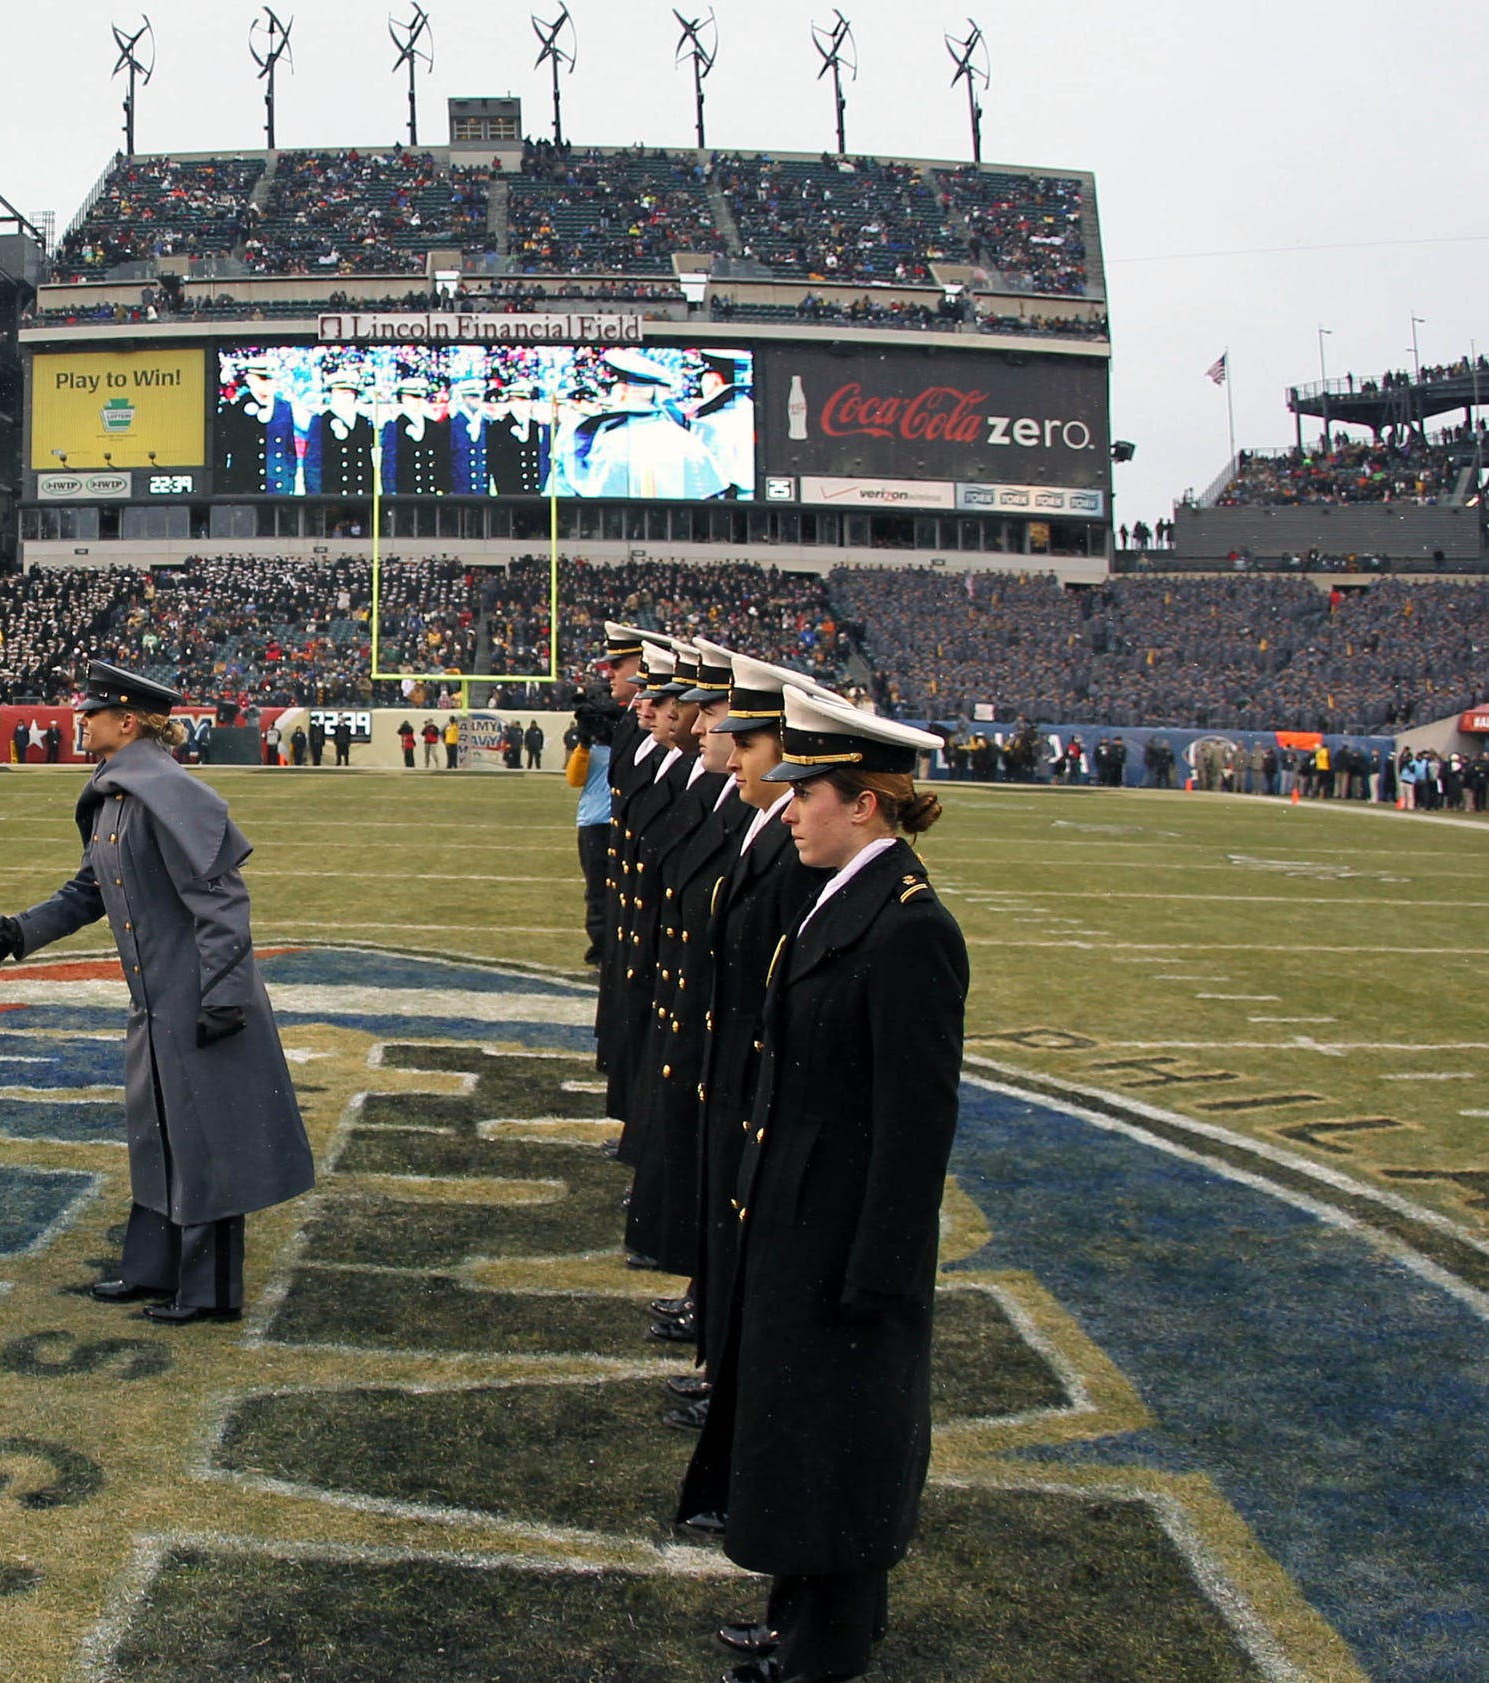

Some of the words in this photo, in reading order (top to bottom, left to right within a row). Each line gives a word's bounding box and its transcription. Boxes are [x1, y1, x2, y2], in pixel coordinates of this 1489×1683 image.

[351, 315, 449, 339] Lincoln
[456, 315, 572, 339] Financial
[578, 316, 640, 340] Field
[55, 372, 100, 394] Play
[107, 372, 127, 388] to
[133, 369, 181, 387] Win!
[820, 382, 991, 443] Coca-Cola
[987, 416, 1091, 449] zero
[149, 475, 193, 493] 22:39
[860, 488, 909, 503] verizon
